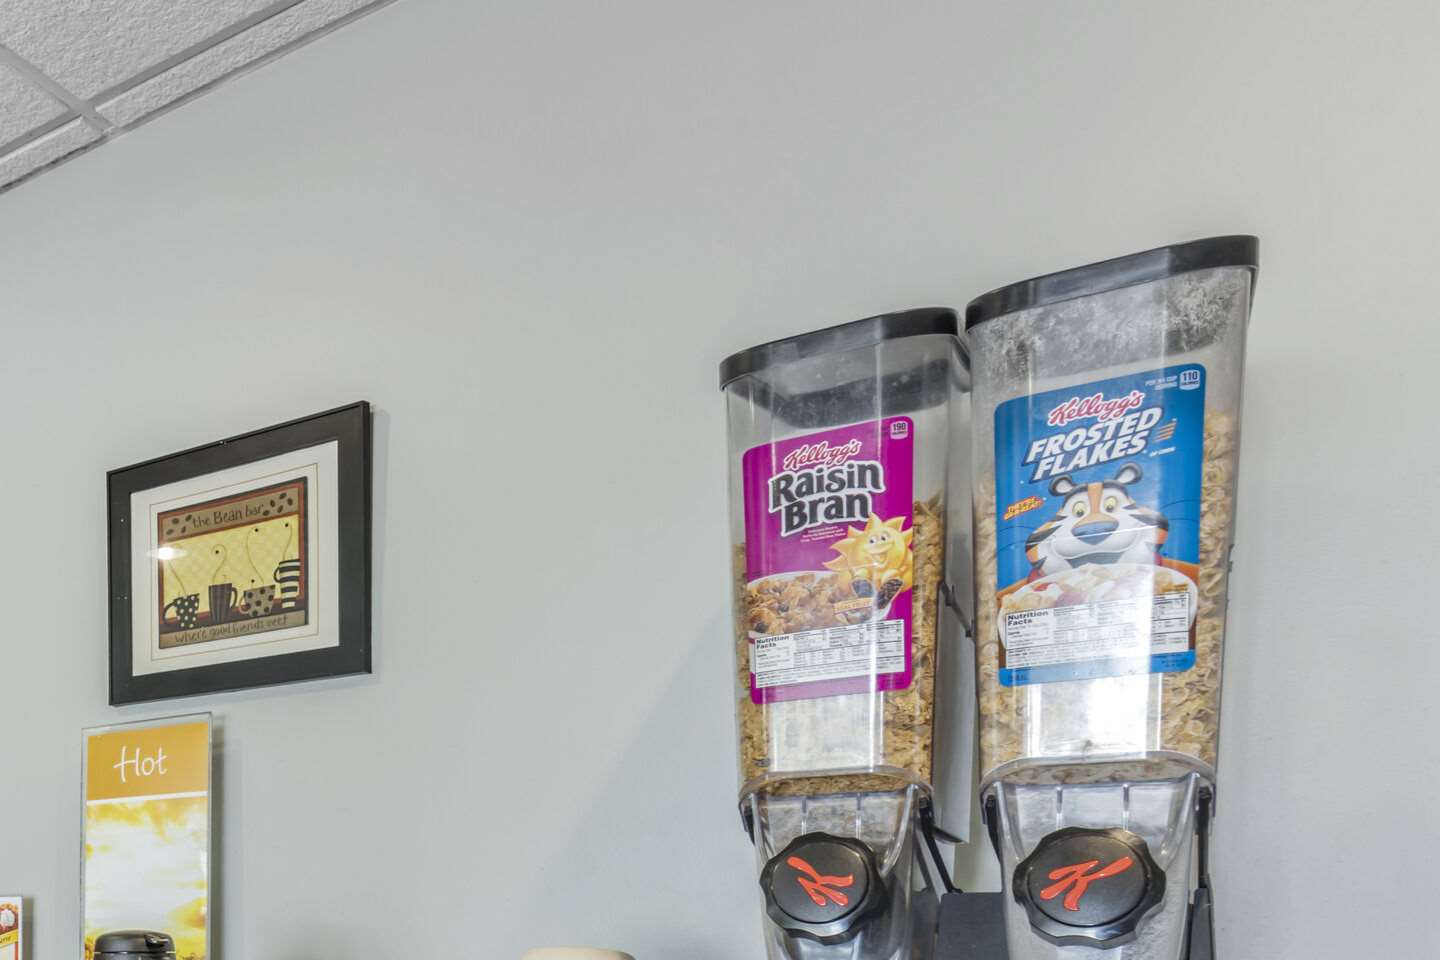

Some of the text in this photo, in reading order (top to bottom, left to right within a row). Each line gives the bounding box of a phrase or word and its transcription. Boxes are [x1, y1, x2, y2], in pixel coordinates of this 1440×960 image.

[1182, 371, 1198, 381] 110
[1048, 390, 1145, 426] Kellogg's
[893, 422, 907, 431] 190
[1025, 407, 1162, 464] FROSTED
[784, 439, 862, 470] Kellogg's
[1032, 431, 1151, 481] FLAKES
[770, 462, 884, 511] Raisin
[193, 515, 209, 529] the
[213, 508, 242, 523] Bean
[783, 493, 871, 534] Bran
[1007, 618, 1033, 627] Facts
[1008, 610, 1049, 621] Nutrition
[756, 635, 790, 645] Nutrition
[112, 745, 168, 783] Hot
